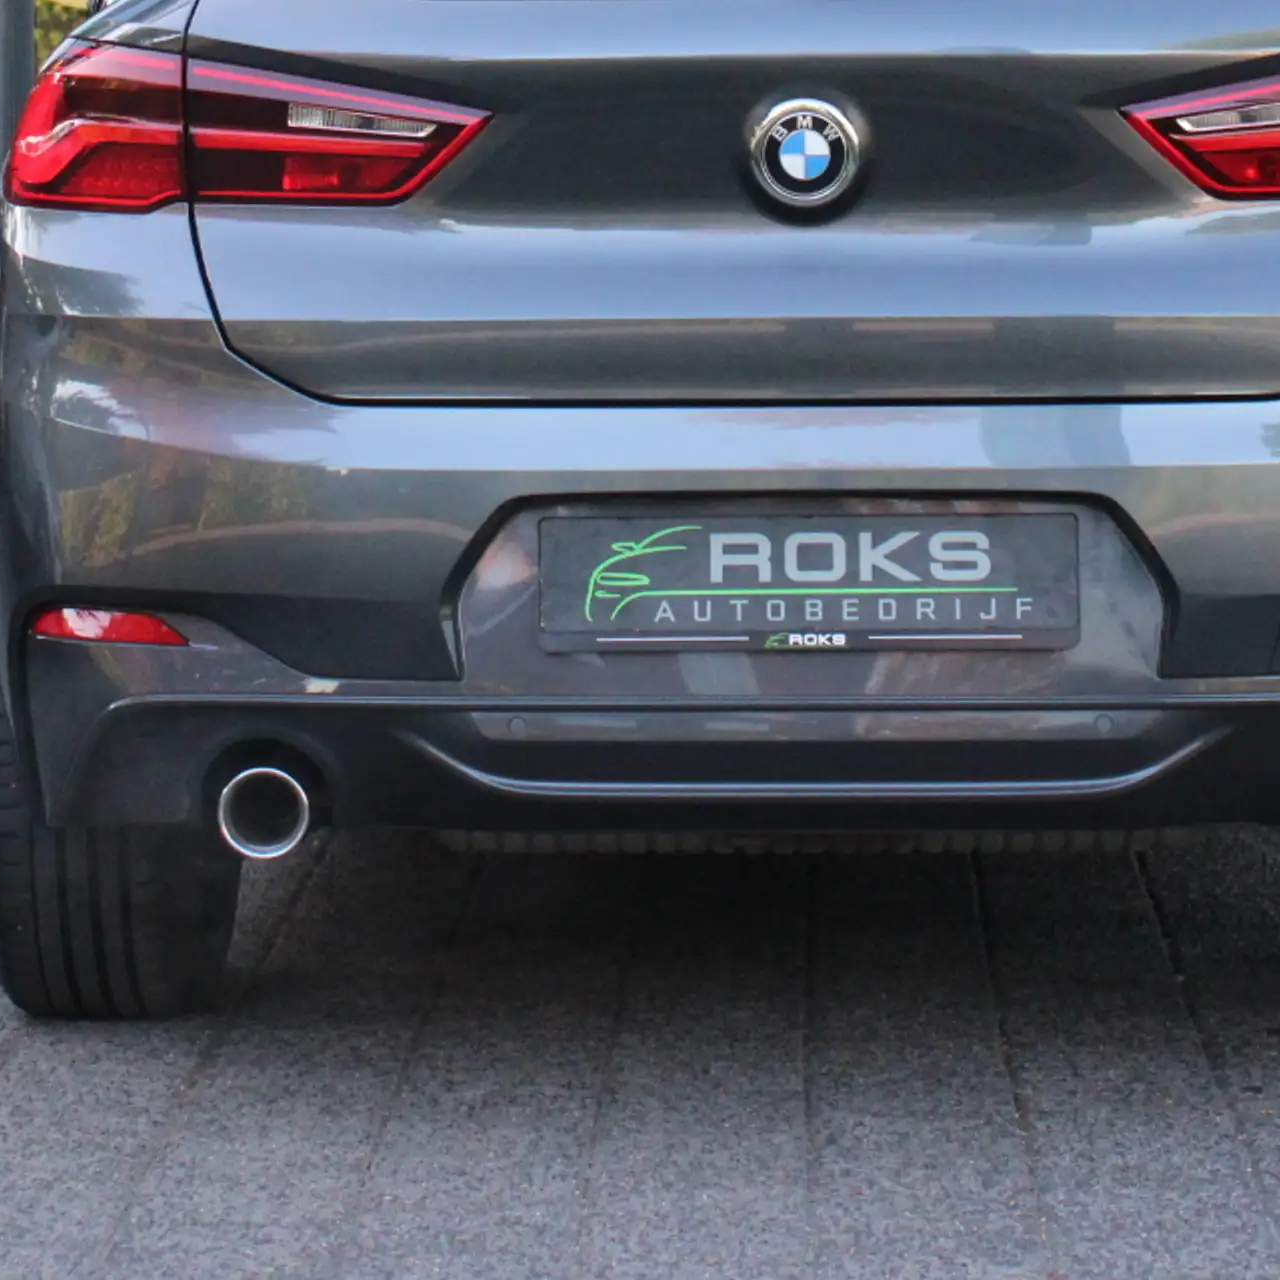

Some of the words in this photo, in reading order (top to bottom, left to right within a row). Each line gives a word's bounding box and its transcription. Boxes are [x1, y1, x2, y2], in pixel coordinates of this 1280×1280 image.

[770, 116, 840, 142] BMW
[709, 531, 992, 584] ROKS
[653, 597, 1033, 623] AUTOBEDRIJF
[788, 633, 847, 646] ROKS
